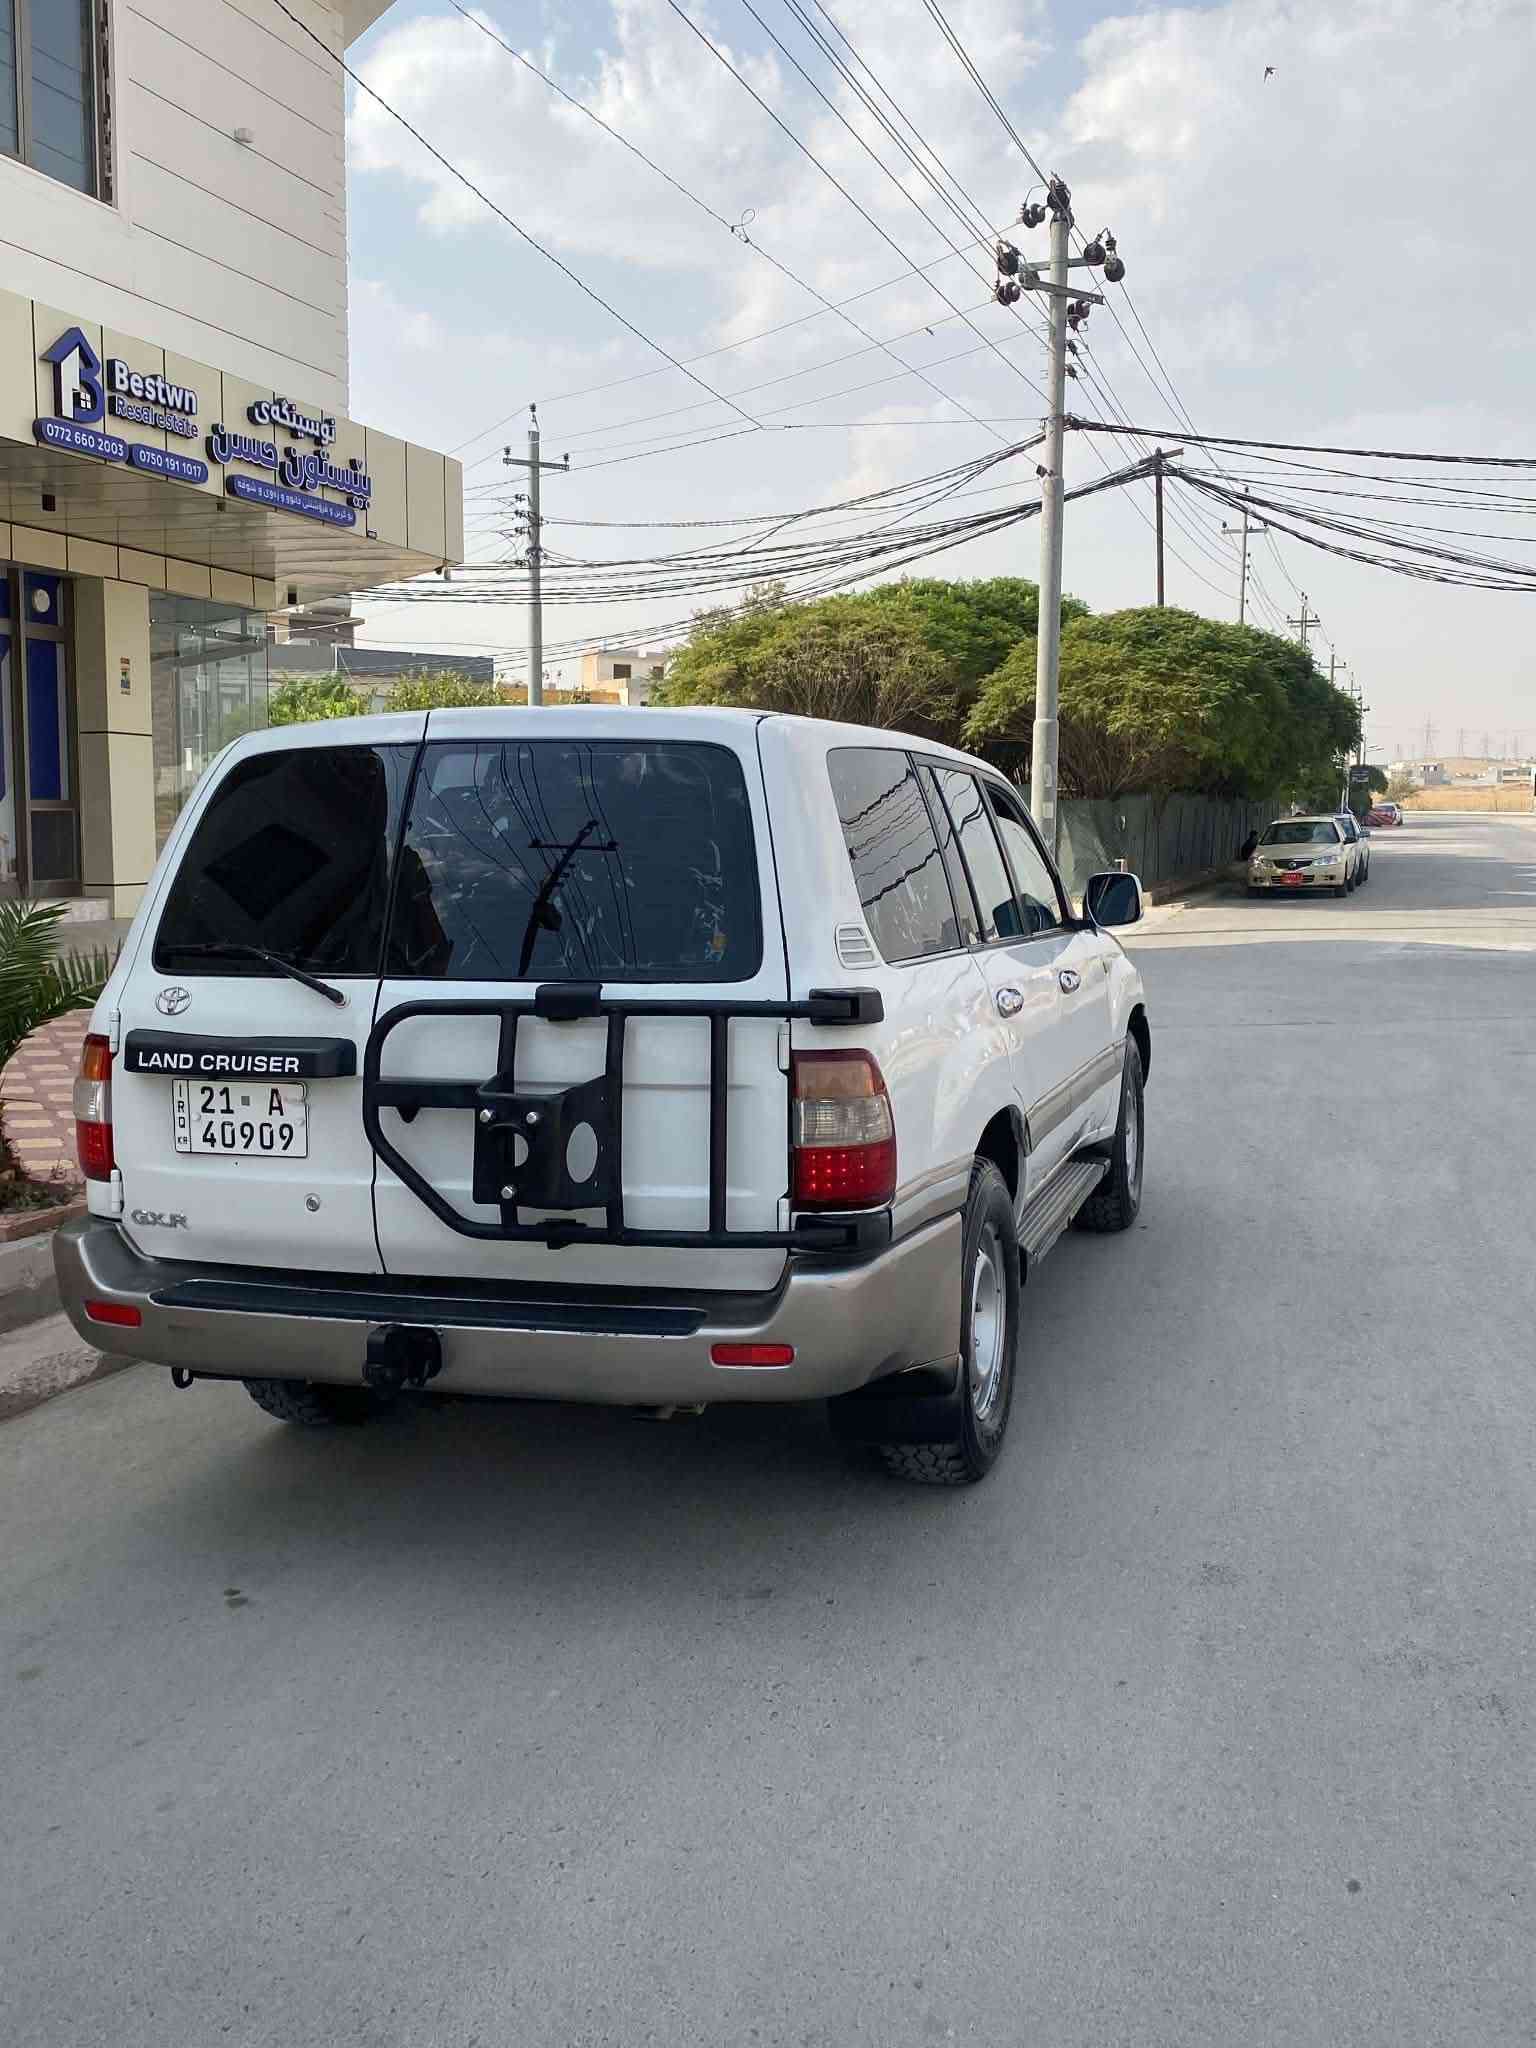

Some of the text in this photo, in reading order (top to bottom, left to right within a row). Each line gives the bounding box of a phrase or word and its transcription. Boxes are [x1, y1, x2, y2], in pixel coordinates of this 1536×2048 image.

[113, 360, 198, 415] Bestwn
[46, 424, 124, 457] 0772 660 2003
[212, 422, 279, 471] حسن
[139, 450, 202, 478] 0750 191 1017
[138, 1051, 300, 1073] LAND CRUISER
[200, 1086, 284, 1116] 21 A
[202, 1120, 294, 1150] 40909
[131, 1209, 188, 1229] GXR
